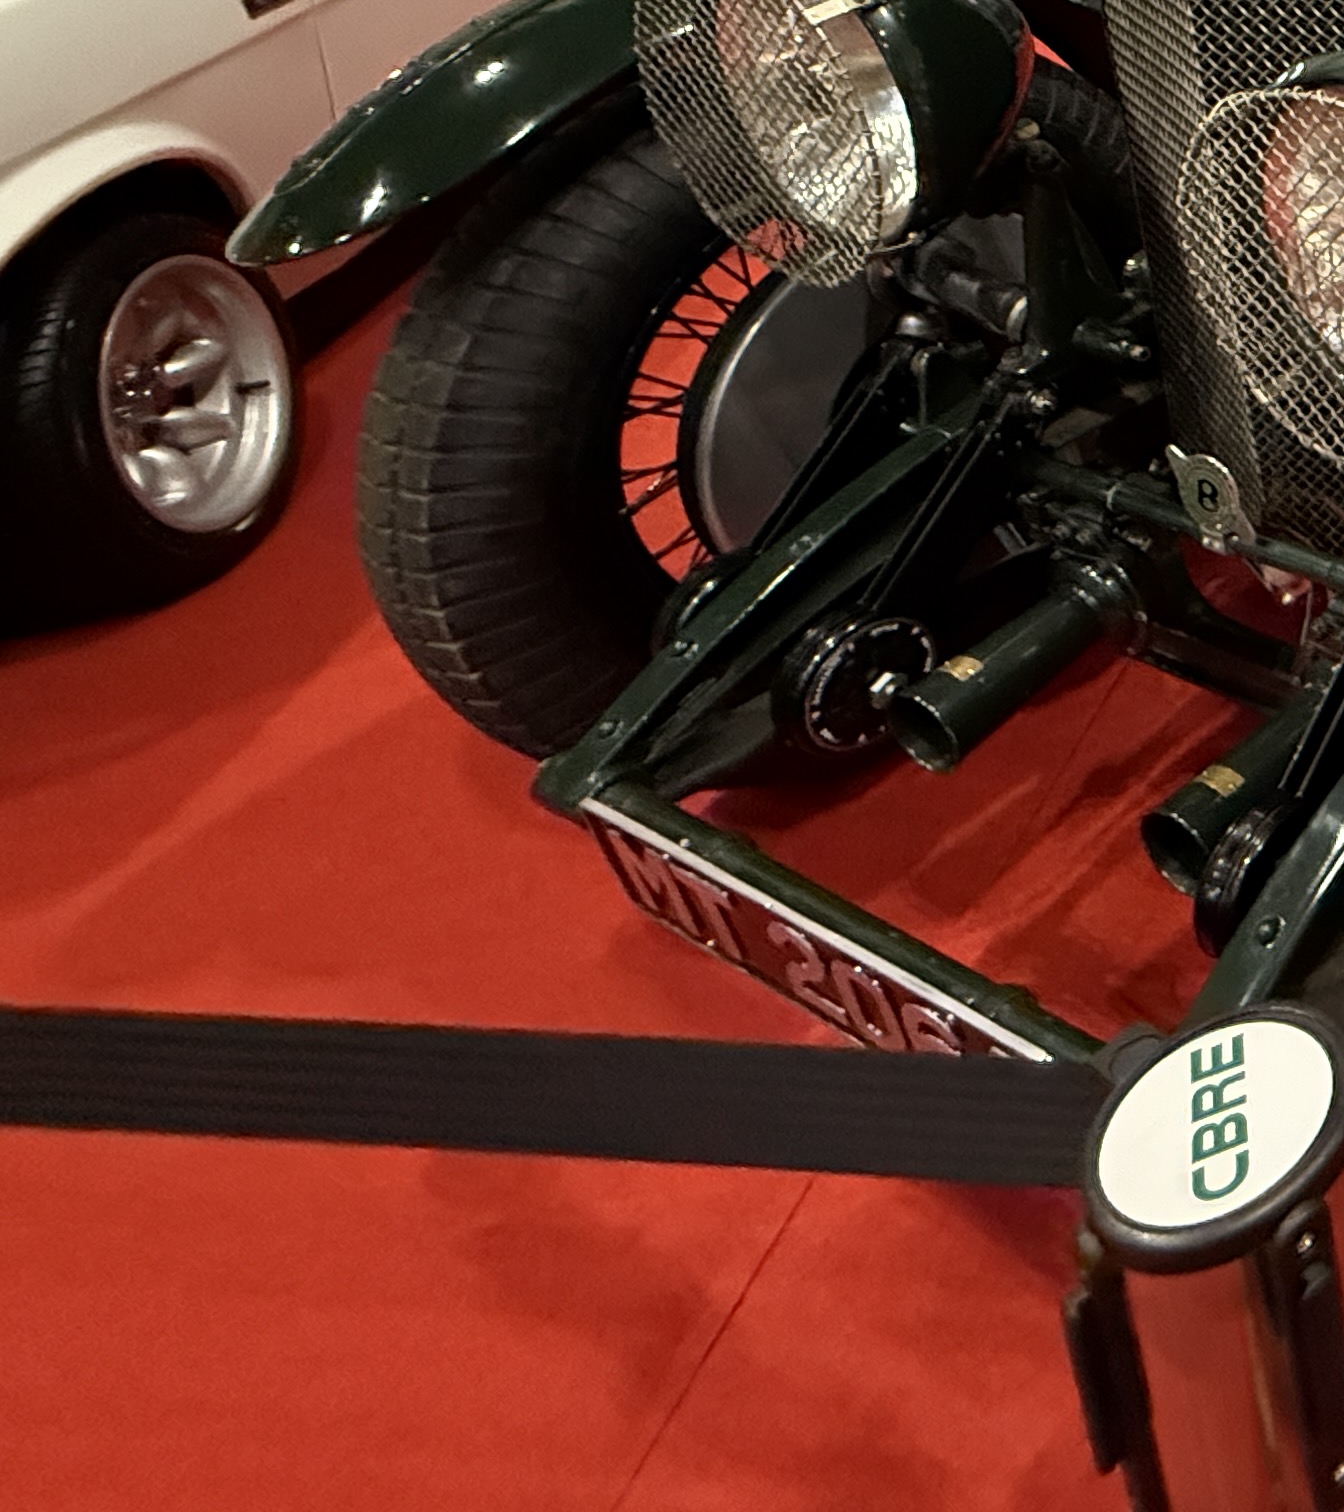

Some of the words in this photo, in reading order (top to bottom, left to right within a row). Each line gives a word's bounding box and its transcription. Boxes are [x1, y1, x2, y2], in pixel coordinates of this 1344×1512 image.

[606, 828, 743, 963] MT
[766, 920, 1010, 1057] 206
[1190, 1032, 1250, 1202] CBRE
